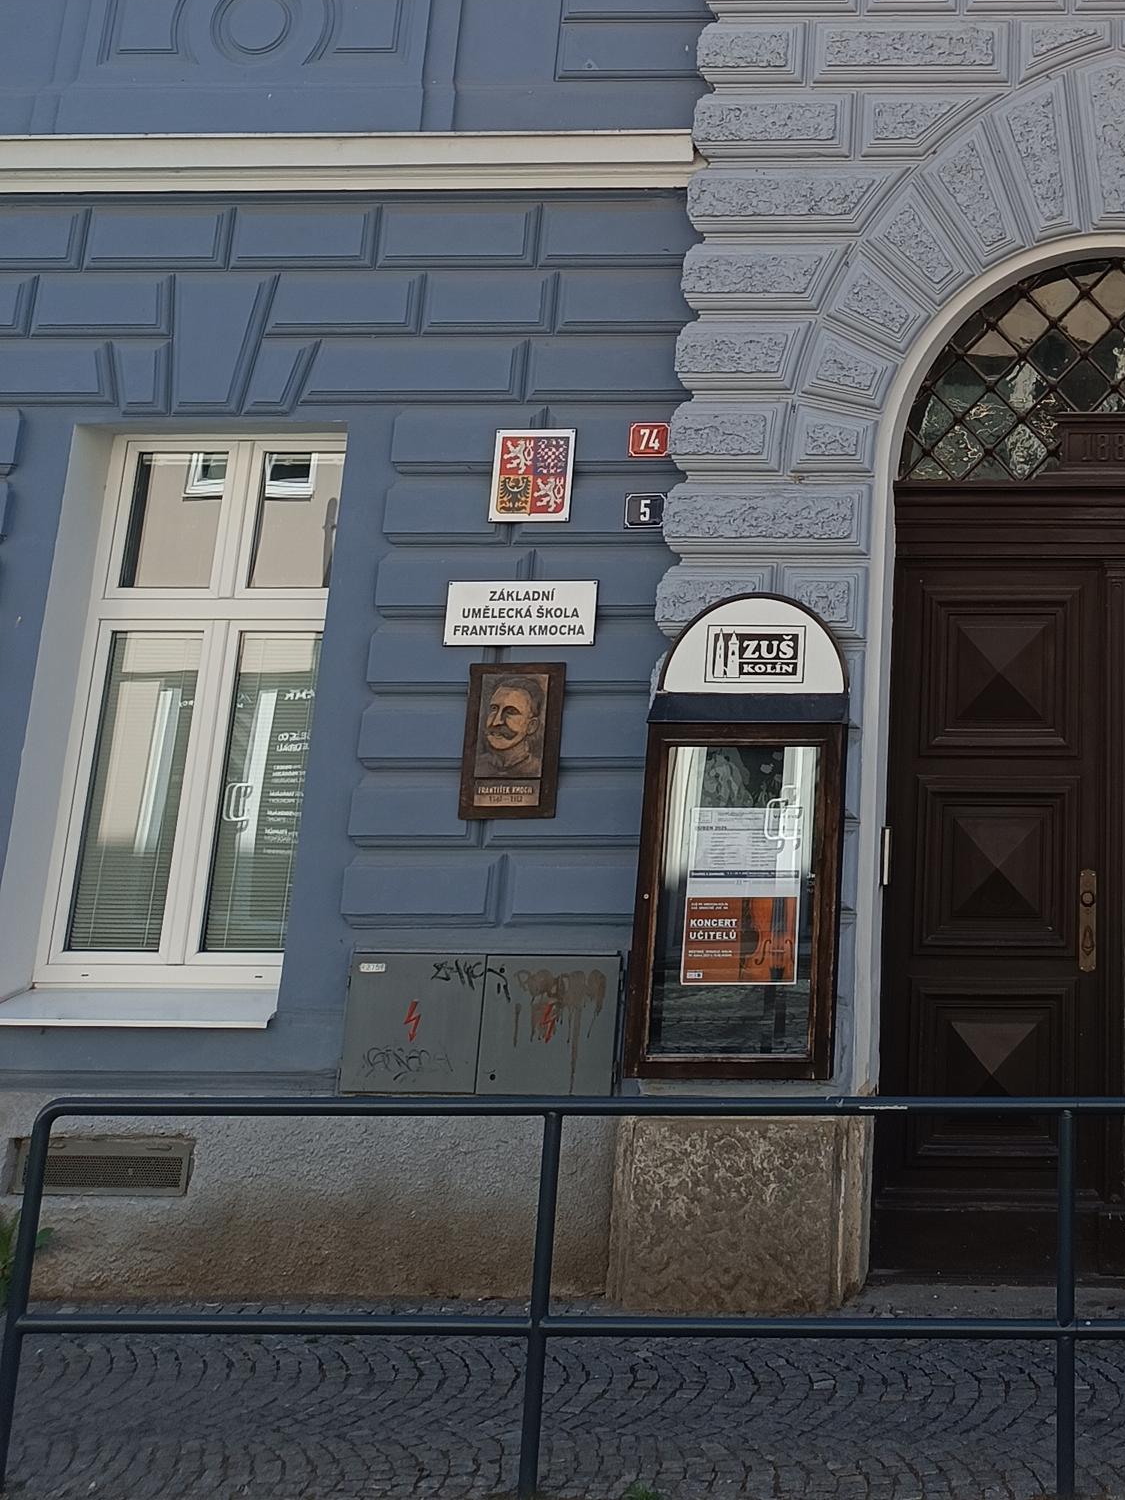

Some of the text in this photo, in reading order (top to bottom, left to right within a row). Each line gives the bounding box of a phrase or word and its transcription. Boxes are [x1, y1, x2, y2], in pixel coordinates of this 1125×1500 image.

[639, 428, 660, 451] 74
[639, 499, 651, 522] 5
[488, 587, 556, 602] ZÁKLADNÍ
[461, 604, 580, 619] UMĚLECKÁ ŠKOLA
[453, 622, 585, 636] FRANTIŠKA KMOCHA
[742, 634, 795, 659] ZUŠ
[742, 662, 794, 673] KOLÍN
[689, 918, 738, 928] KONCERT
[689, 929, 737, 940] UČITELŮ
